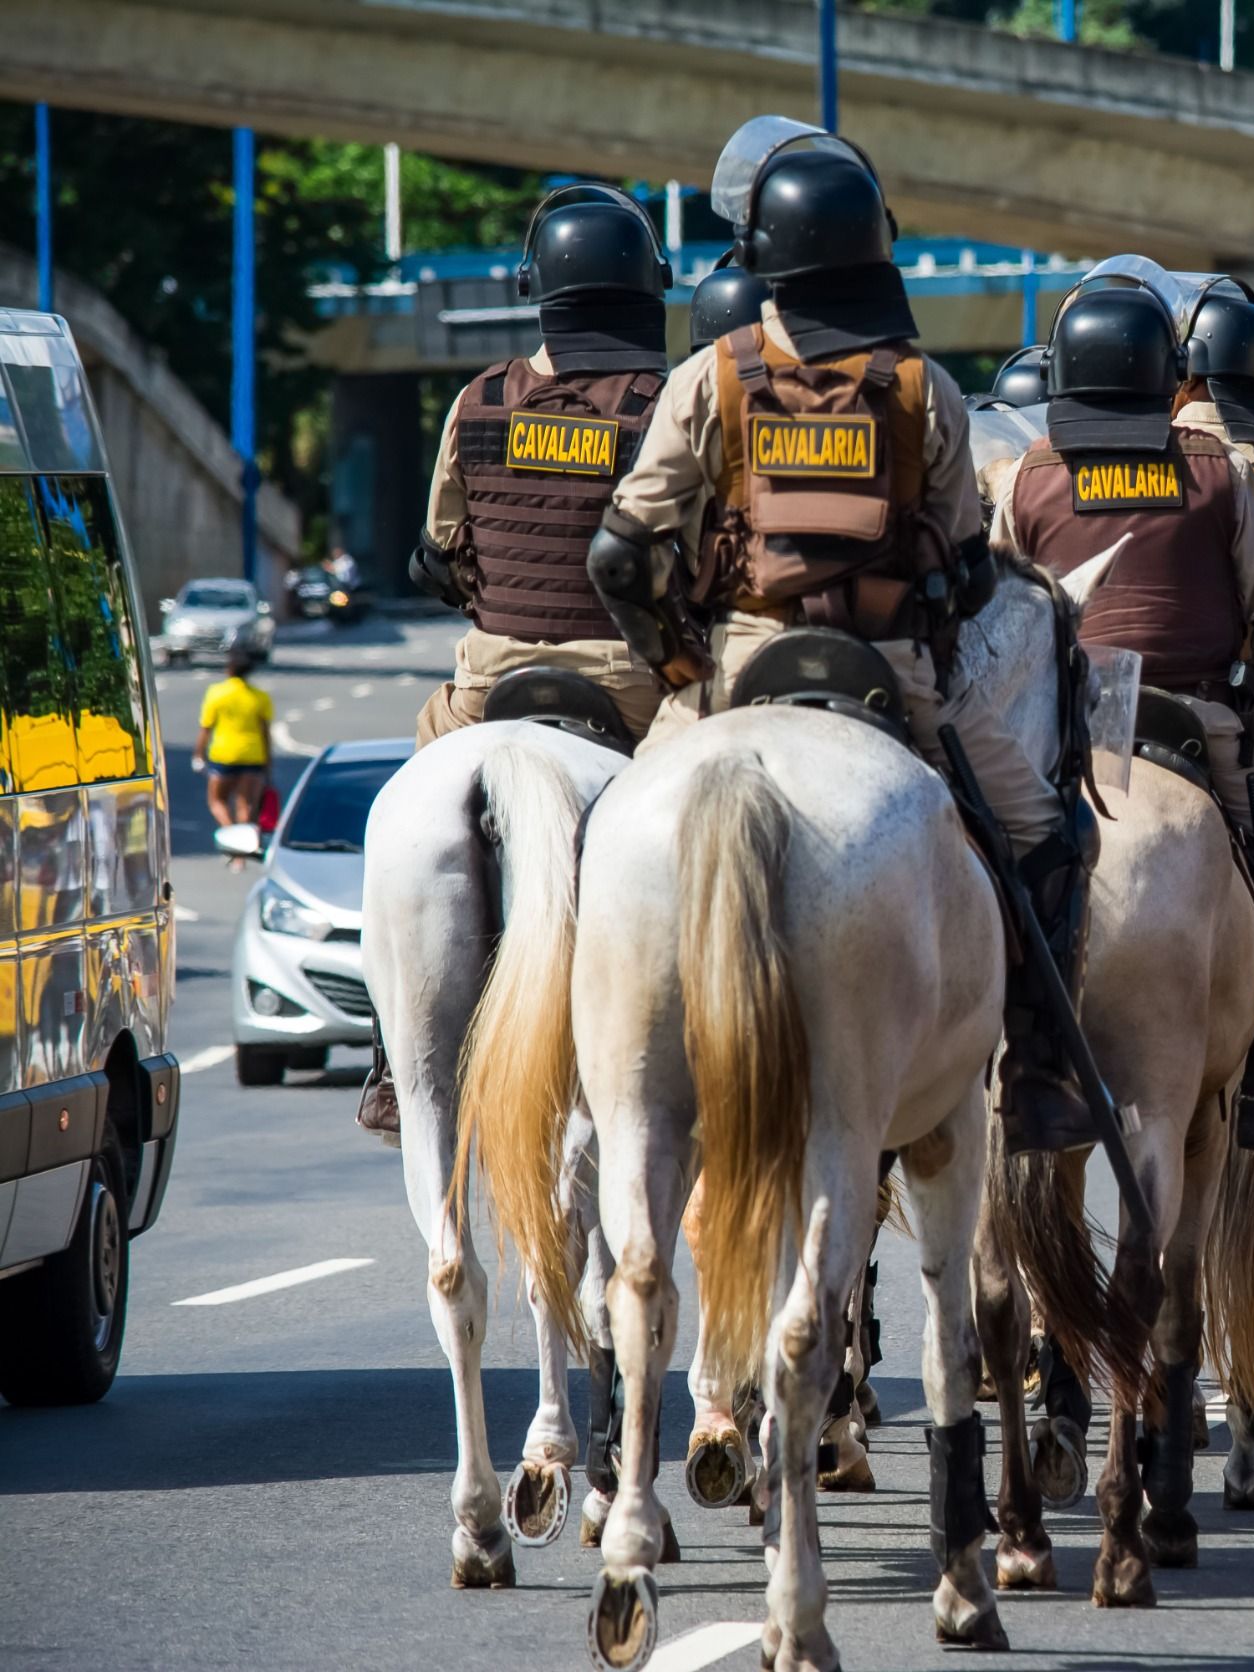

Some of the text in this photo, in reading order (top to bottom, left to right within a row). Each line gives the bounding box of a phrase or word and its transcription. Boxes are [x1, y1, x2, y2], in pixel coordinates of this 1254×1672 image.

[513, 421, 611, 466] CAVALARIA
[758, 426, 867, 467] CAVALARIA
[1078, 463, 1180, 502] CAVALARIA
